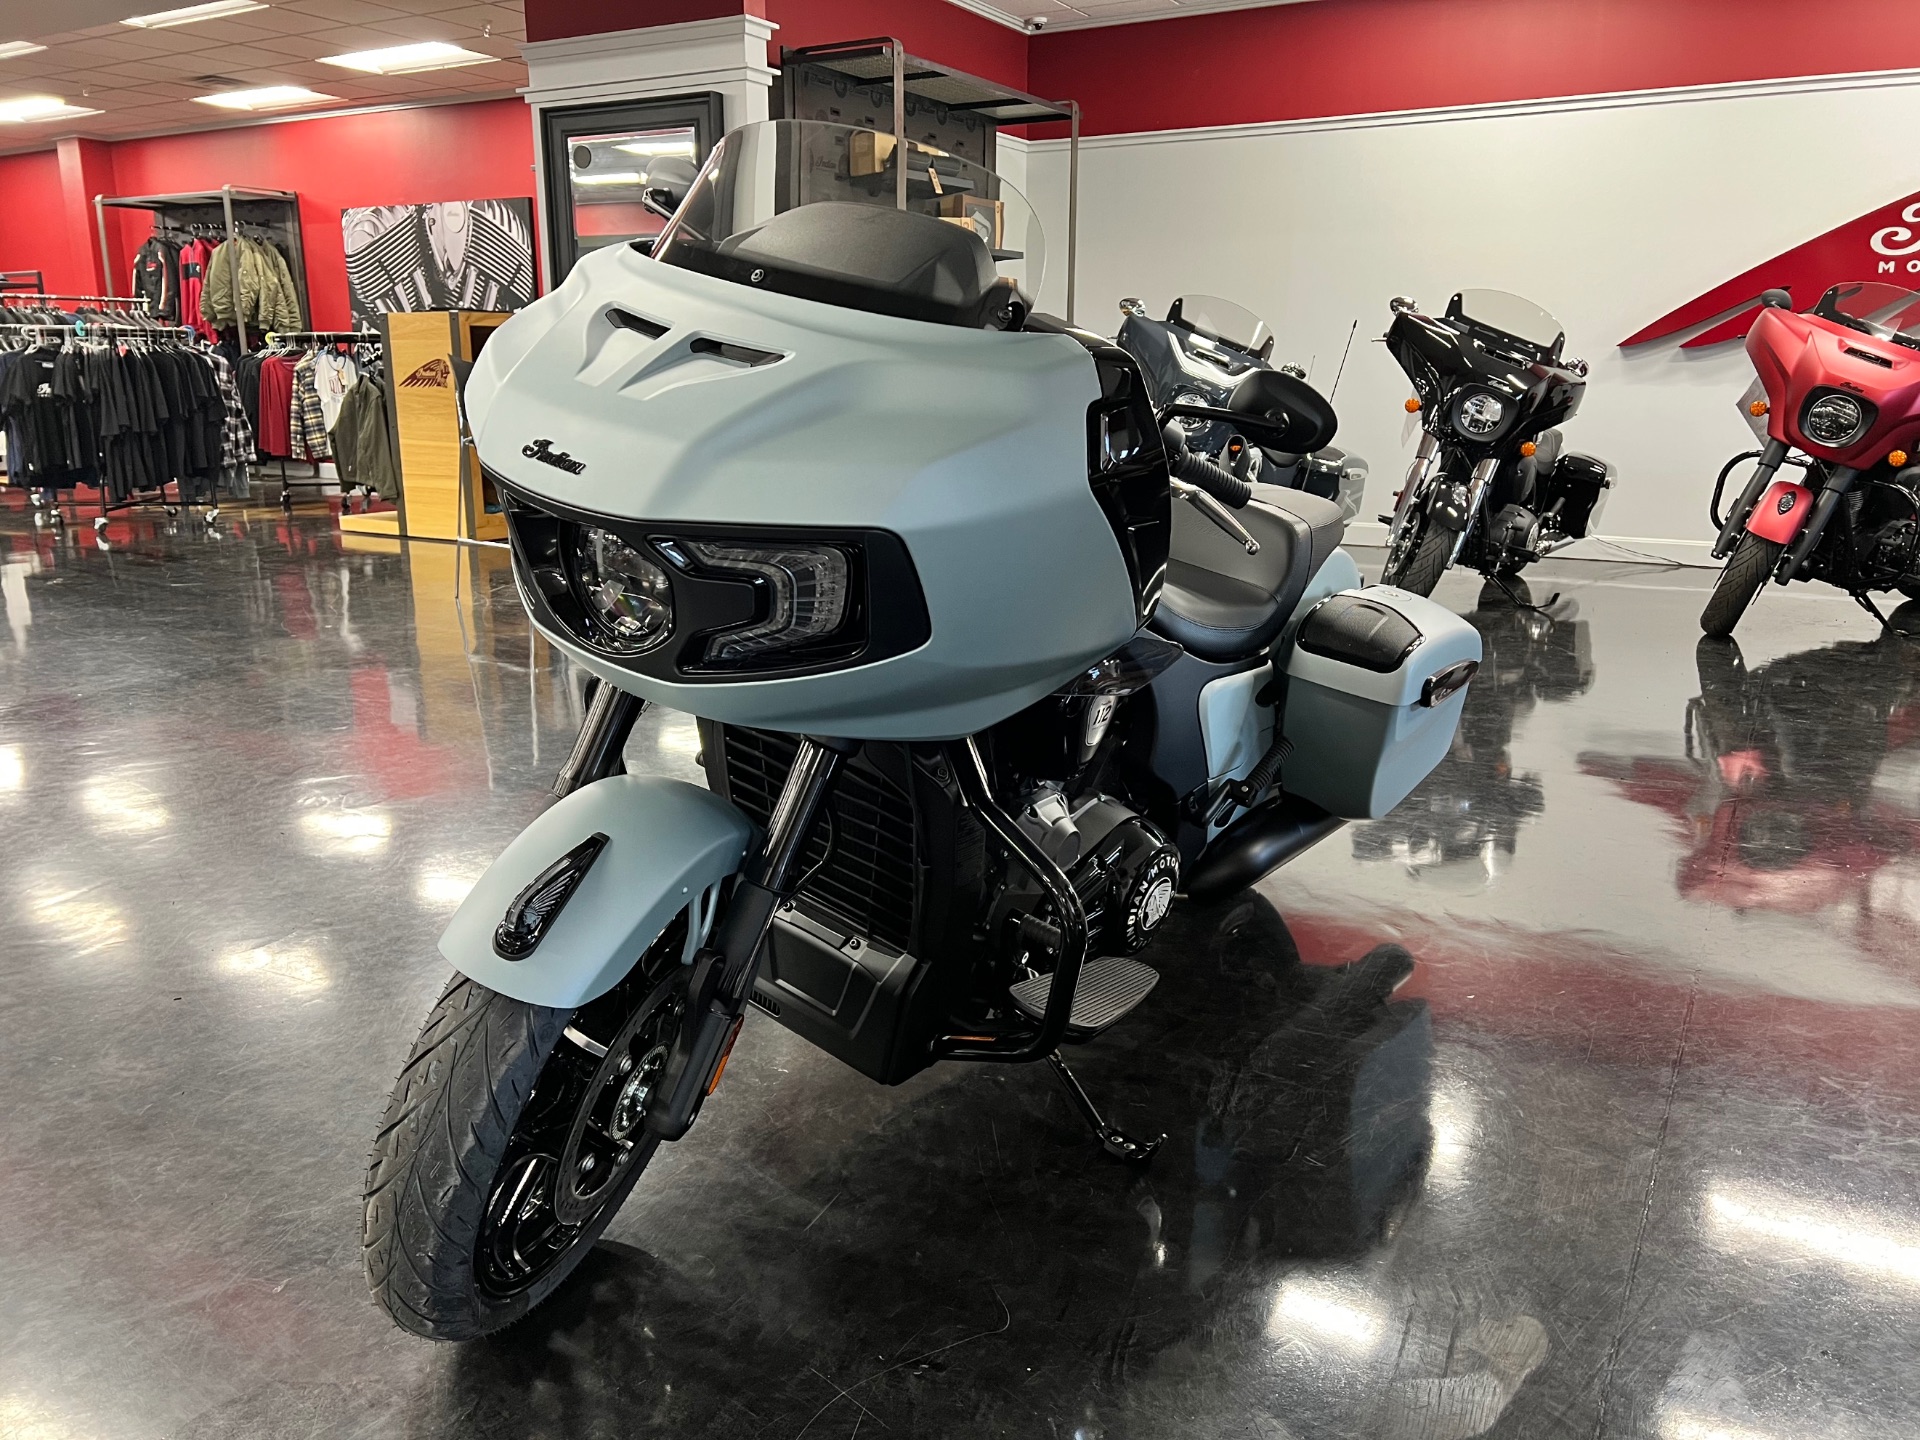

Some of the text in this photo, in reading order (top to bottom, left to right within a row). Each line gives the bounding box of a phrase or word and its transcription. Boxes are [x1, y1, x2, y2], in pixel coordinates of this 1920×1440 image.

[521, 439, 586, 475] Indian
[1093, 705, 1112, 725] 112
[1126, 881, 1149, 942] INDIAN
